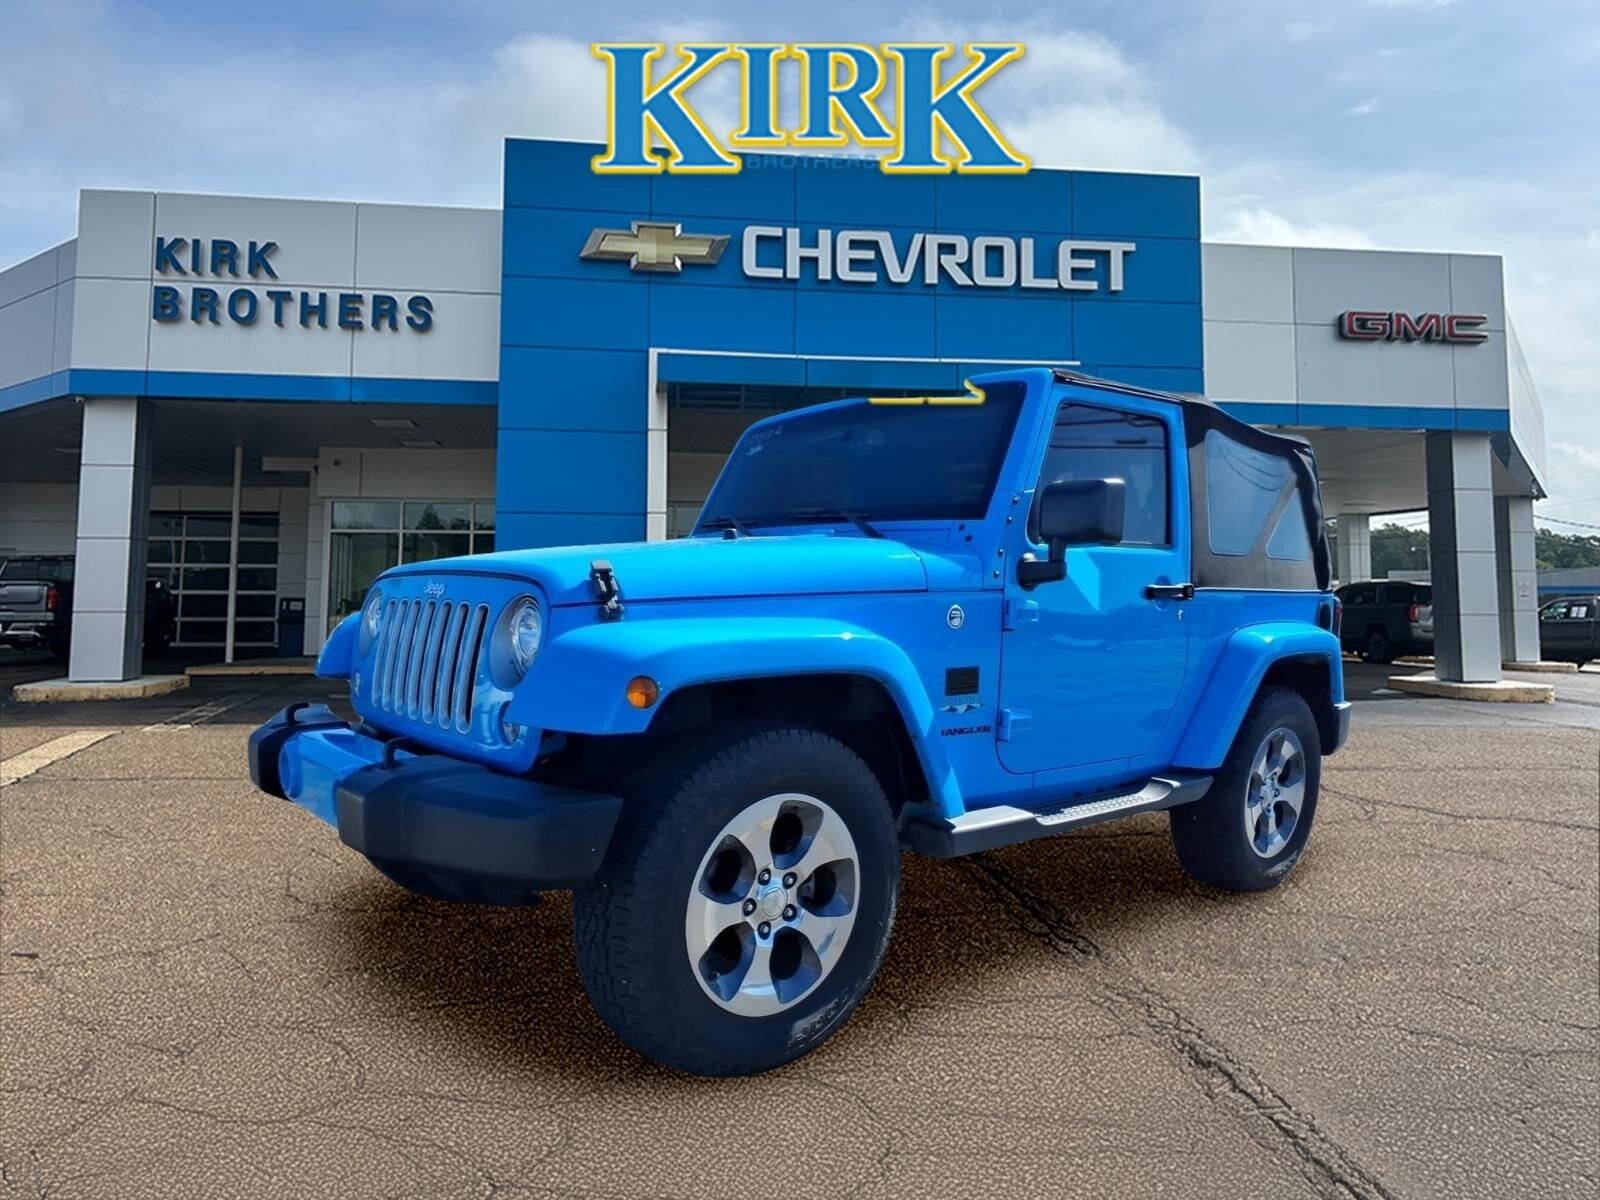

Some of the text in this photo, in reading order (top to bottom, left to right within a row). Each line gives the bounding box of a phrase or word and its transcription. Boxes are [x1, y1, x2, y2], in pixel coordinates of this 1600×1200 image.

[155, 236, 279, 279] KIRK
[742, 225, 1137, 292] CHEVROLET
[152, 286, 434, 332] BROTHERS
[1340, 310, 1488, 345] GMC
[423, 579, 446, 598] Jeep
